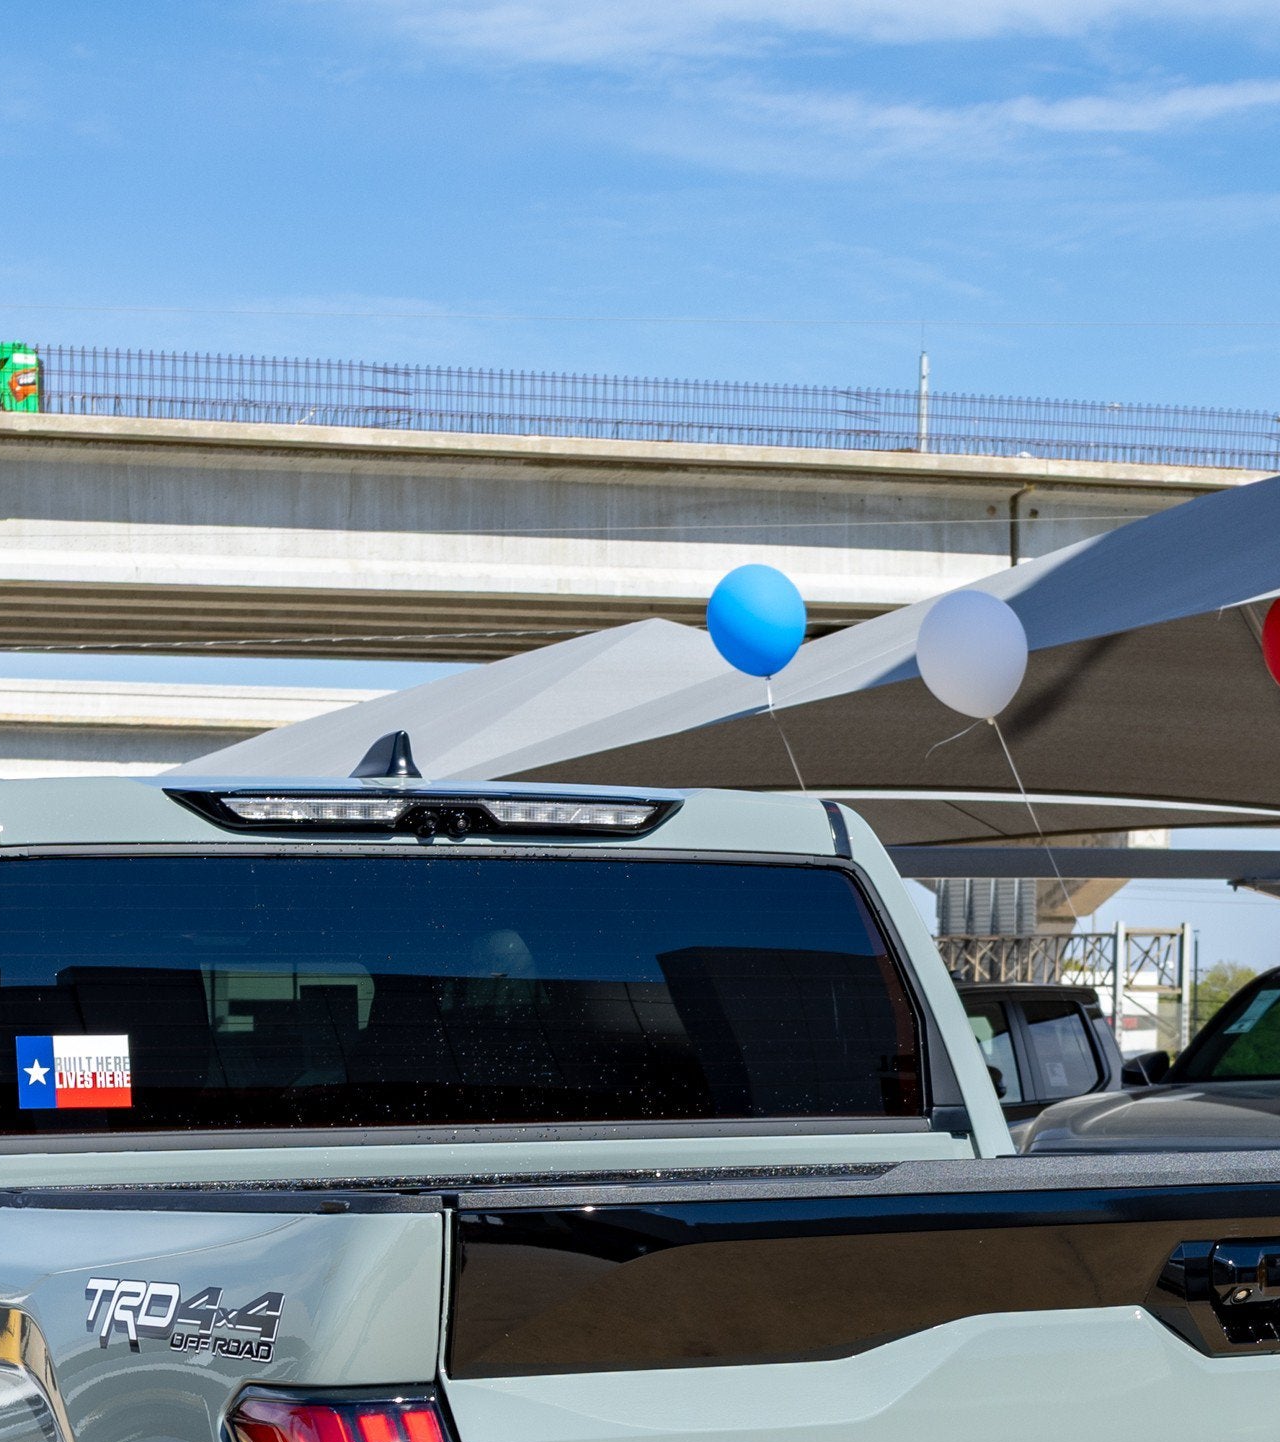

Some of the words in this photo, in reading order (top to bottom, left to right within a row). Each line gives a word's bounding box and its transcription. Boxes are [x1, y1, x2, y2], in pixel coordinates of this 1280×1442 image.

[55, 1056, 93, 1072] BUILT
[96, 1056, 130, 1072] HERE
[55, 1071, 93, 1089] LIVES
[96, 1071, 132, 1088] HERE
[84, 1276, 181, 1354] TRD
[169, 1331, 214, 1355] OFF
[212, 1336, 274, 1364] ROAD
